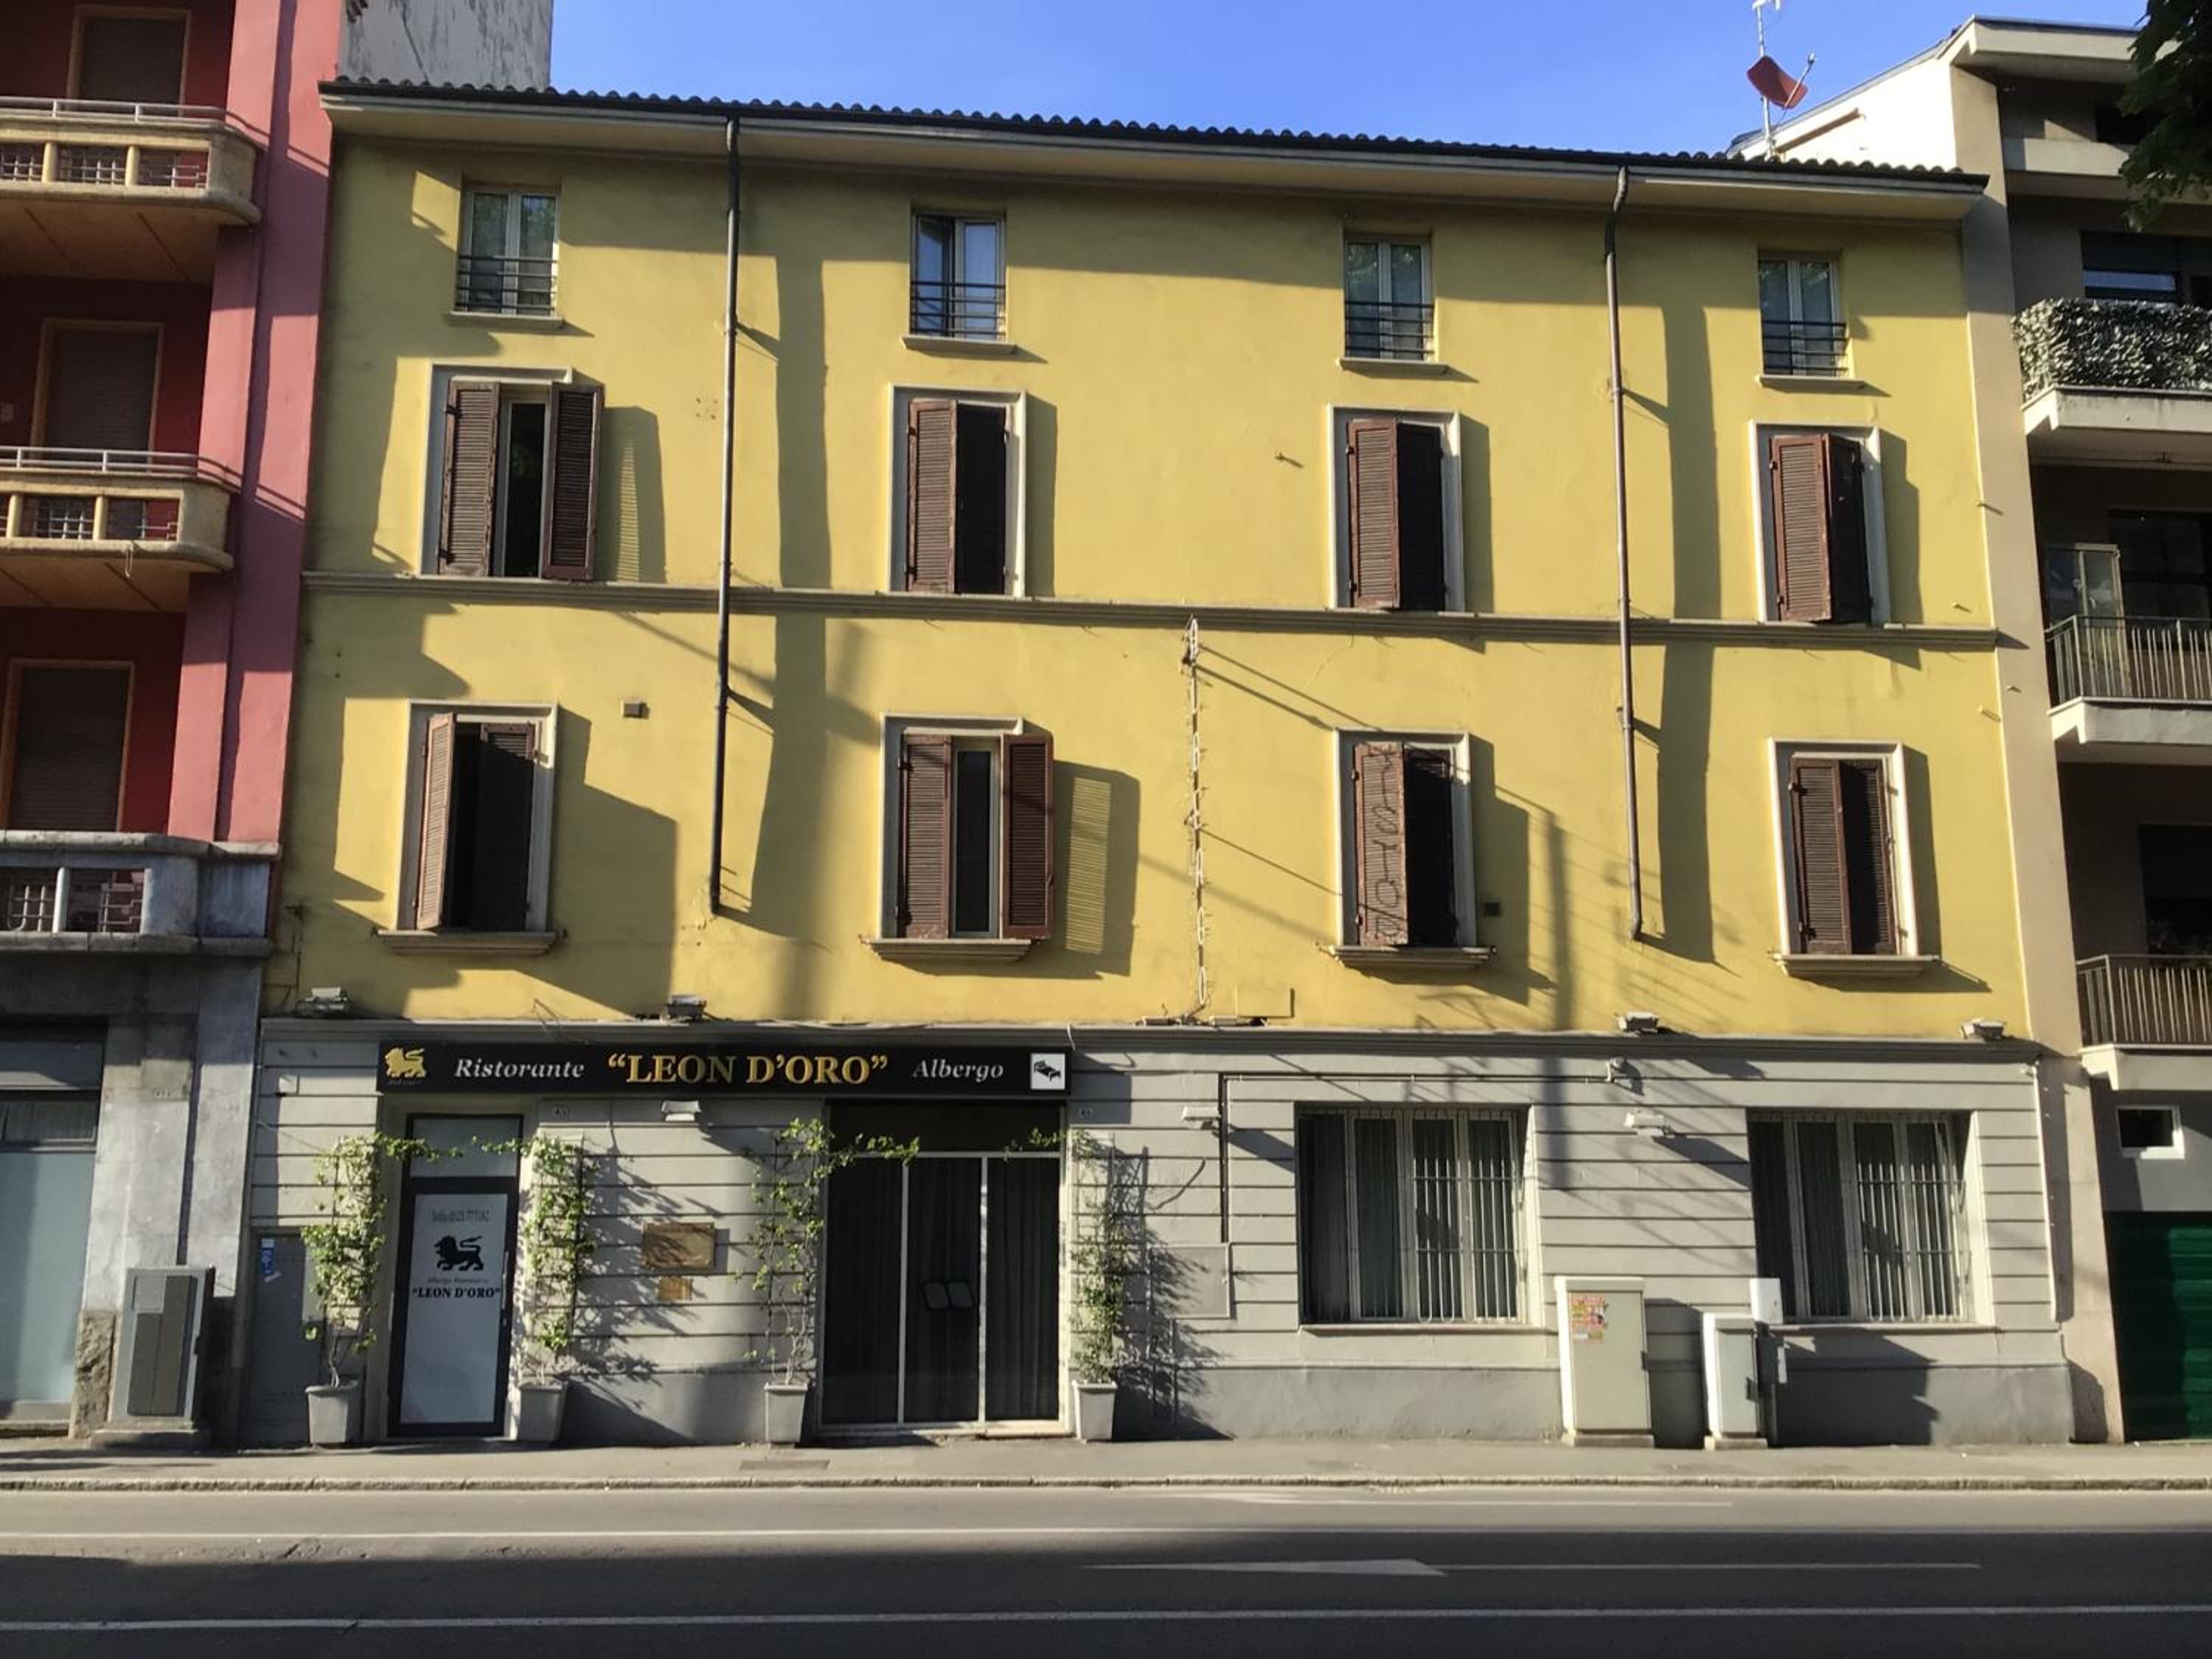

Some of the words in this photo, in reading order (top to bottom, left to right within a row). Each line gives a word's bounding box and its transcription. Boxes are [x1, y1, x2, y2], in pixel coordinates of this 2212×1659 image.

[455, 1058, 585, 1079] Ristorante
[608, 1052, 737, 1084] “LEON
[745, 1053, 888, 1085] D’ORO”
[911, 1059, 1004, 1084] Albergo
